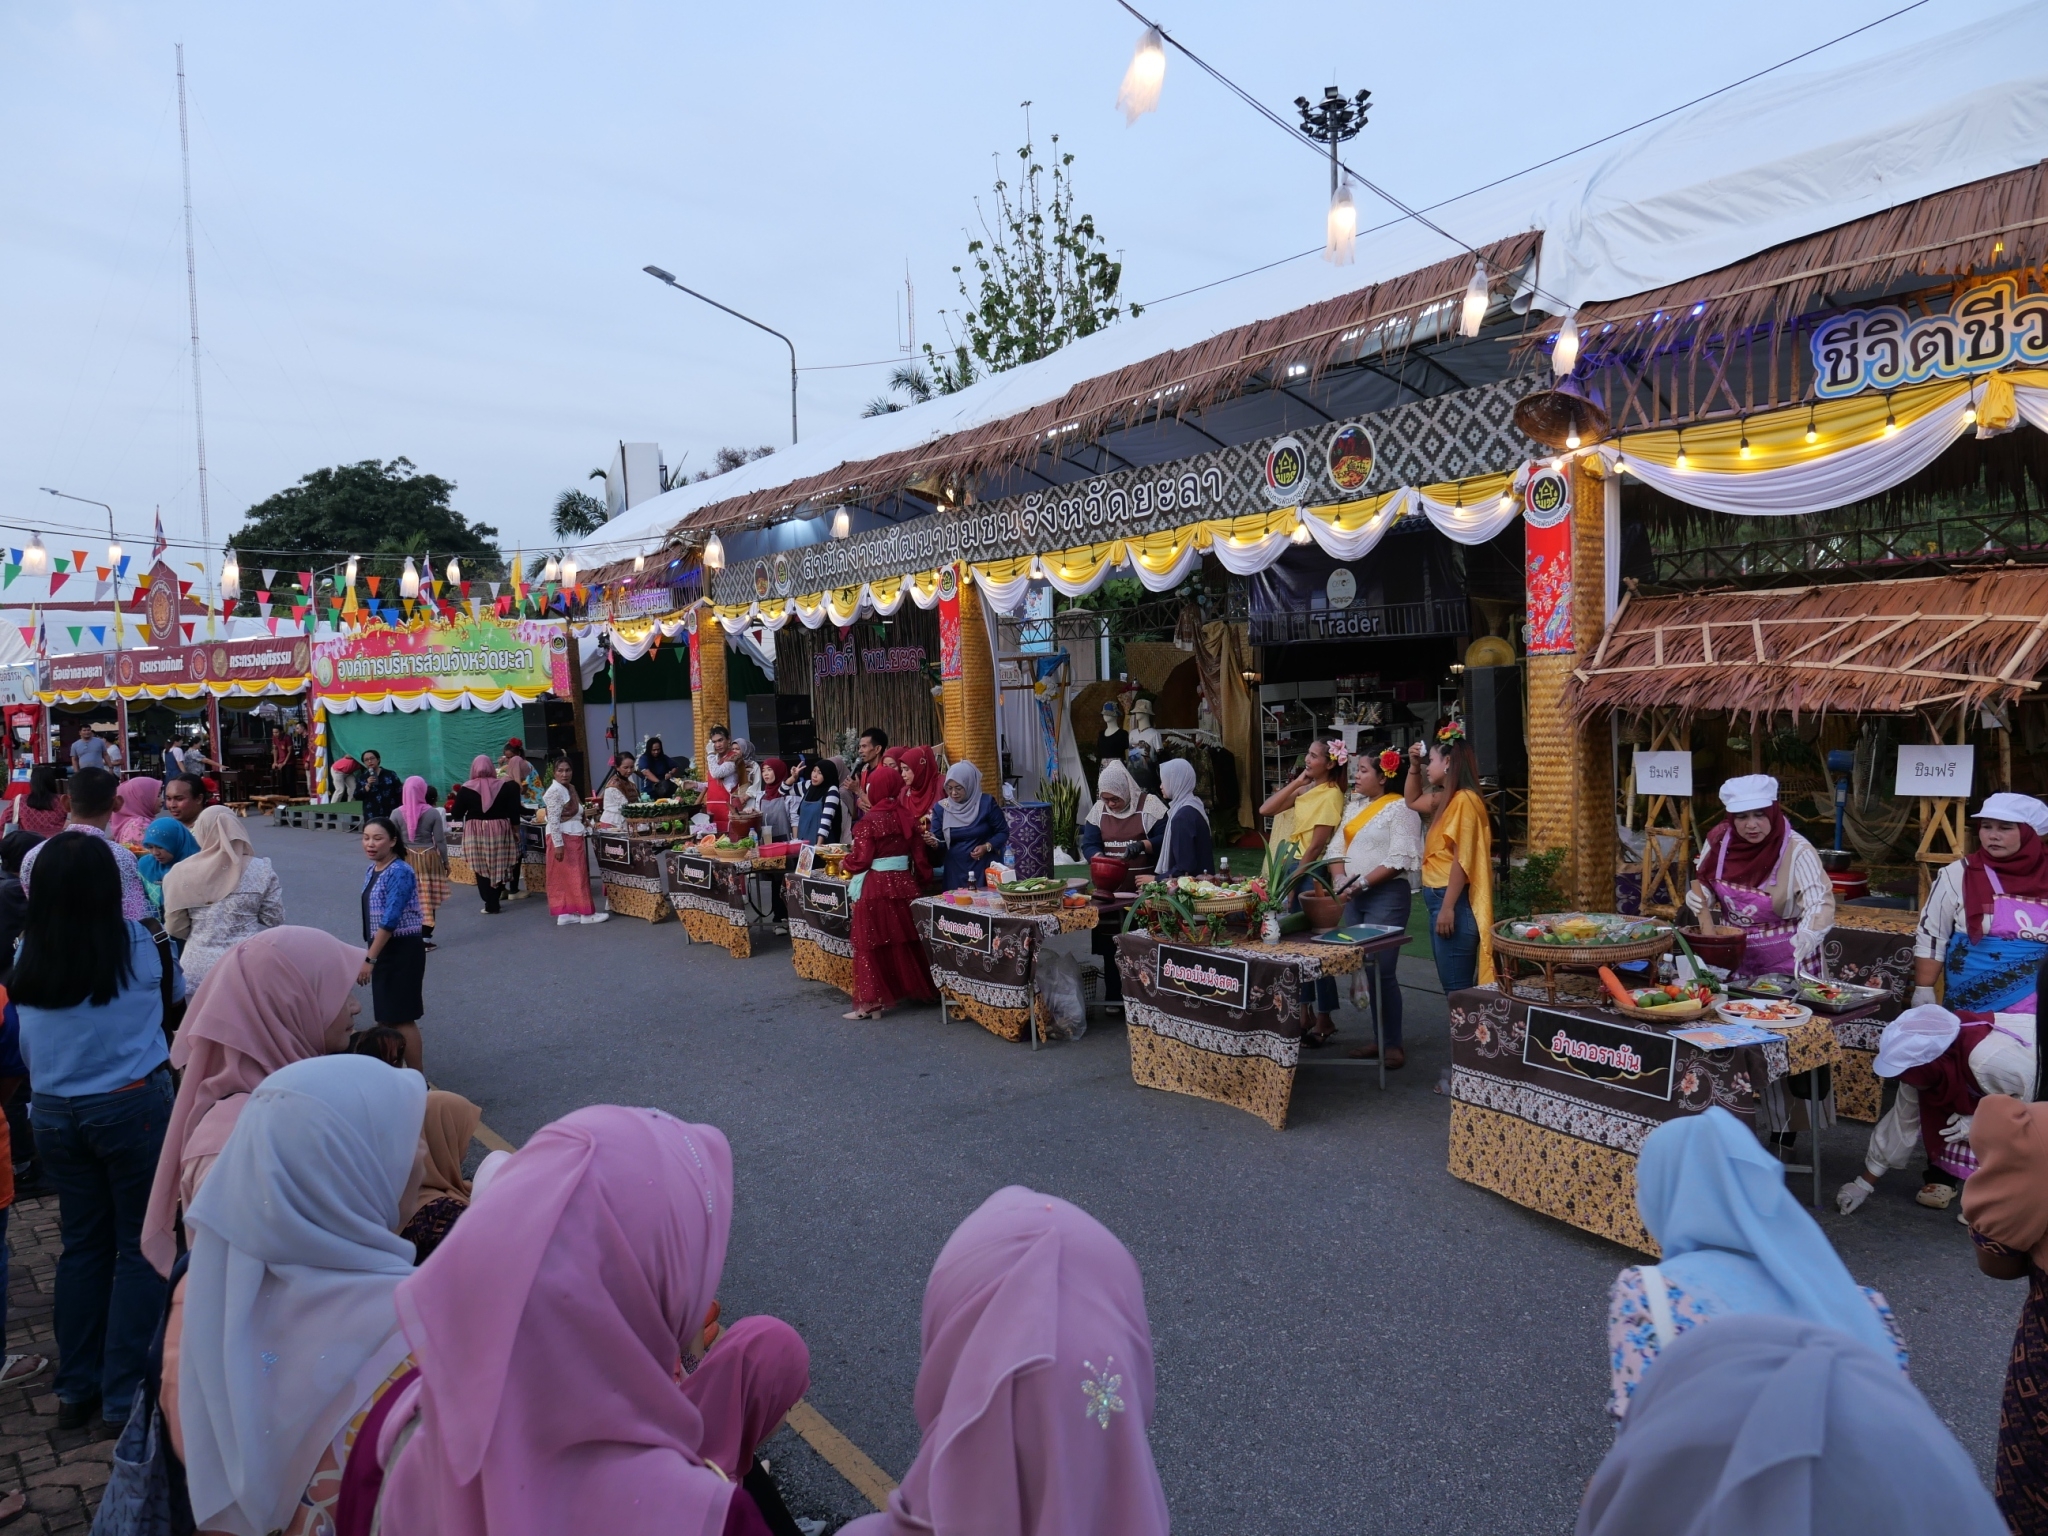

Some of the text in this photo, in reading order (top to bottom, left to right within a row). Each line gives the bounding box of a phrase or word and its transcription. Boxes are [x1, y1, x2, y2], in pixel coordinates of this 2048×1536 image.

[803, 467, 1223, 578] สำนักงานพัฒนาชุมชนจังหวัดยะลา
[1315, 614, 1379, 635] Trader
[139, 654, 184, 674] กรมราชทัณฑ์
[229, 649, 292, 671] กระทรวงยุติธรรม
[337, 644, 534, 679] องค์การบริหารส่วนจังหวัดยะลา
[814, 633, 857, 686] ุขใจที่
[1648, 765, 1680, 780] ชิมฟรี
[1914, 761, 1957, 778] ชิมฟรี
[1163, 957, 1239, 993] อำเภอบันนังสตา
[1551, 1029, 1642, 1073] อำเภอรามัน
